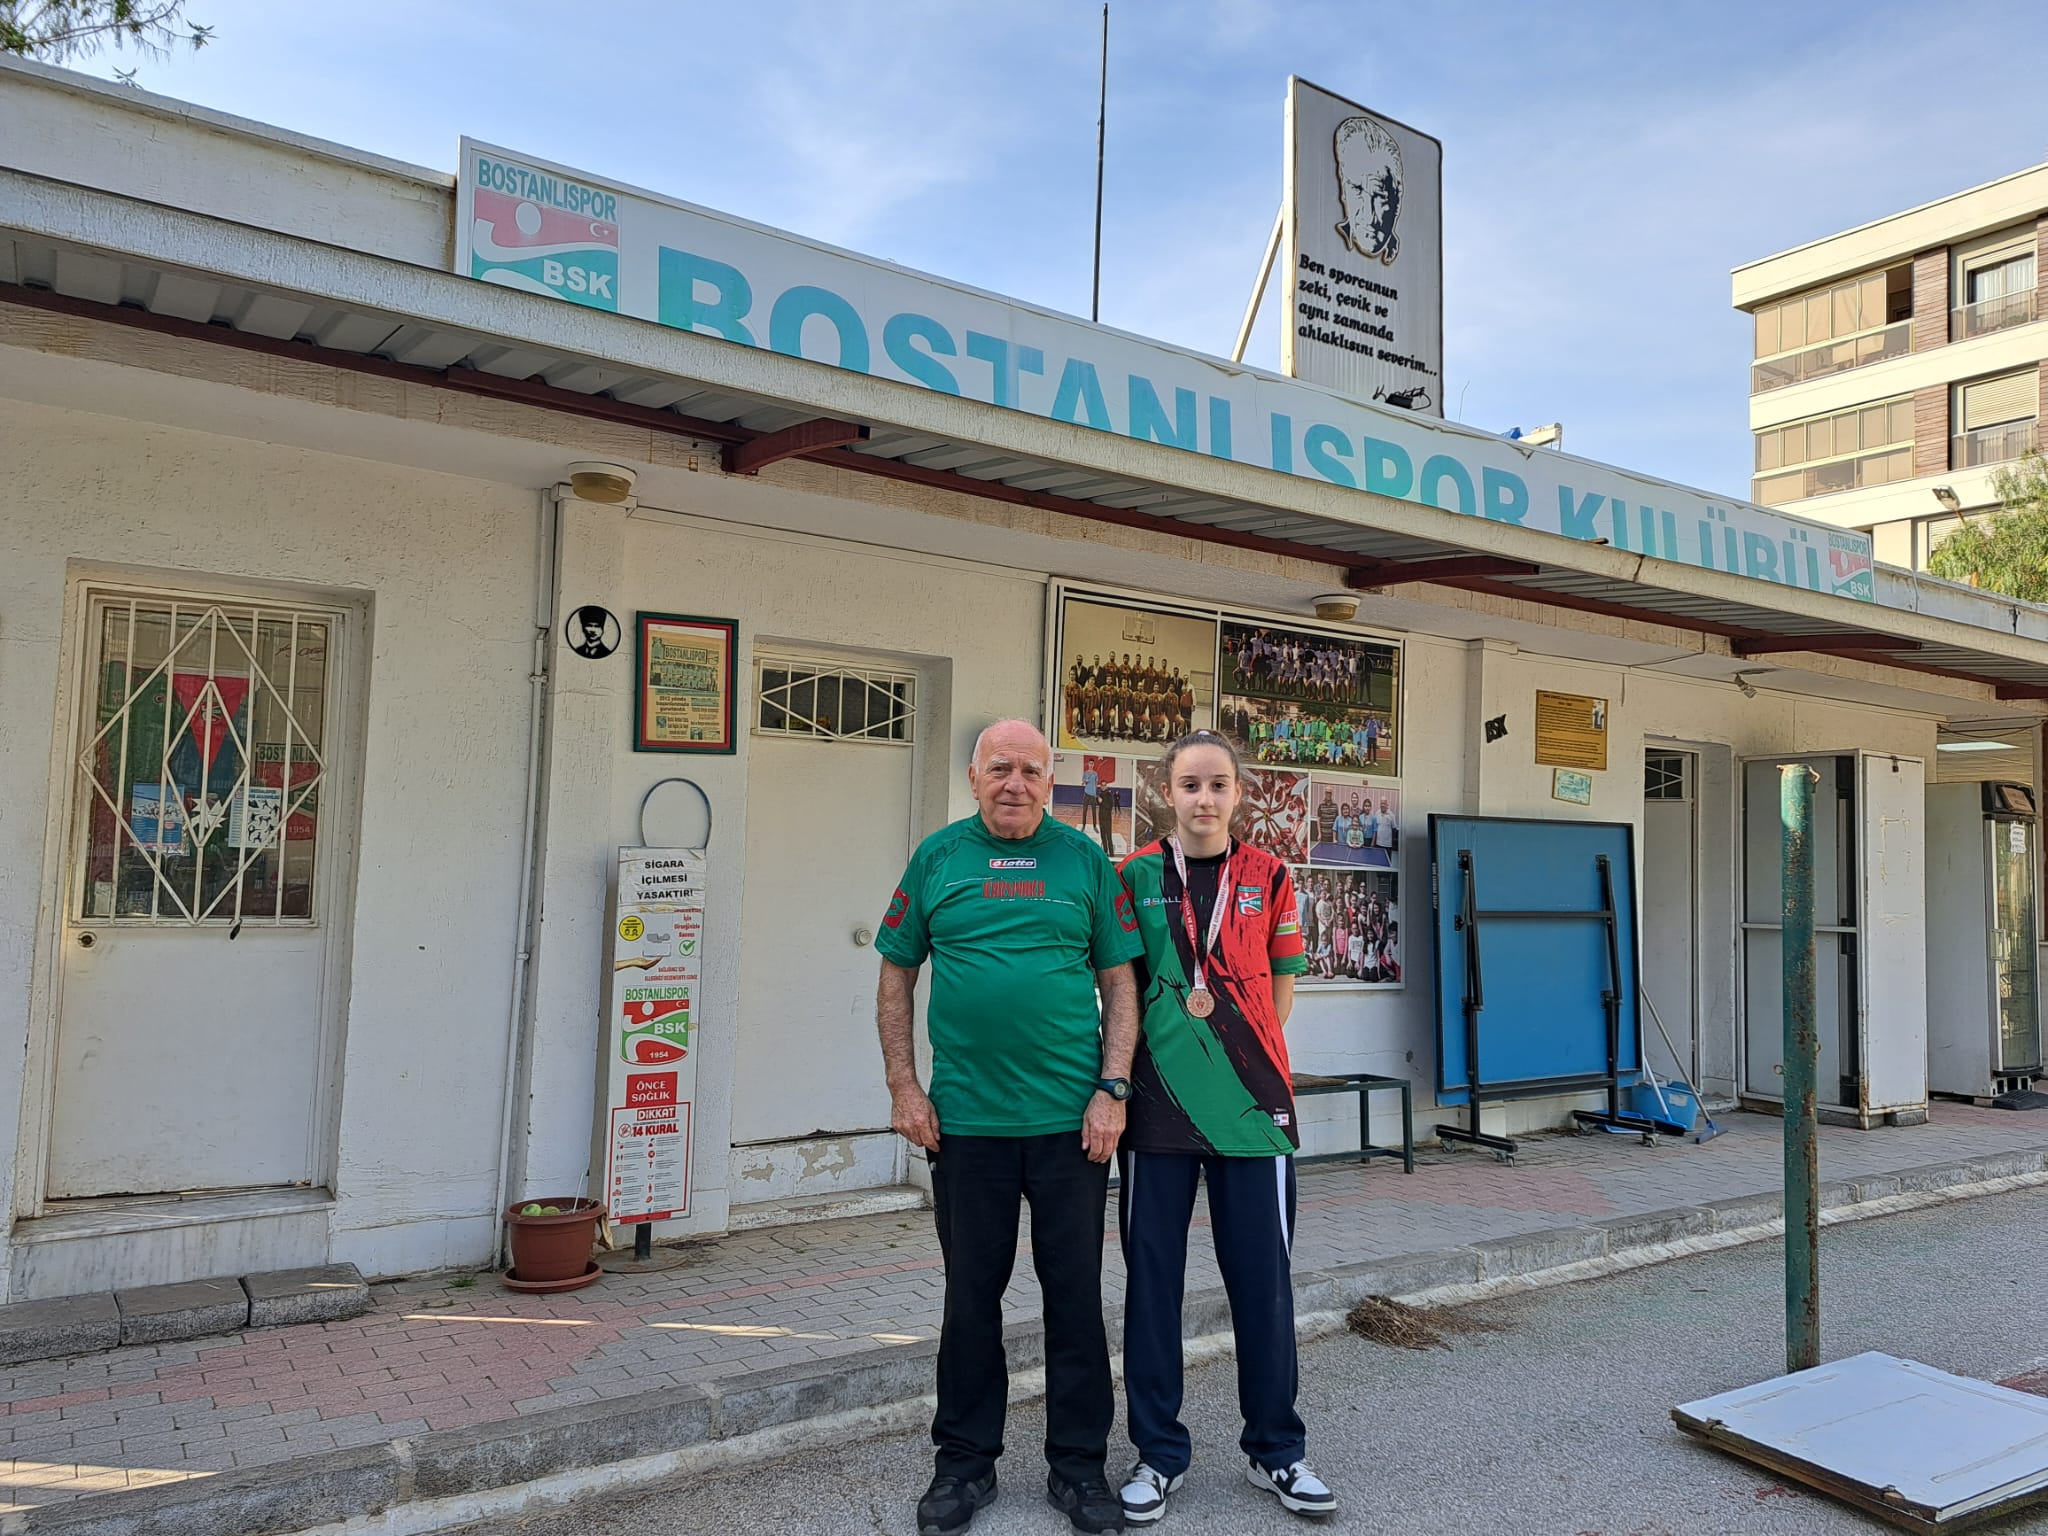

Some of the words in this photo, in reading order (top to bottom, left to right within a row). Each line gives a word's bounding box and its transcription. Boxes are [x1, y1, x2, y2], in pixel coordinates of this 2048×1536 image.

[479, 158, 617, 222] BOSTANLISPOR
[543, 258, 613, 300] BSK
[1299, 253, 1325, 276] Ben
[1328, 267, 1398, 301] sporcunun
[1298, 279, 1332, 302] zeki,
[1336, 292, 1371, 313] çevik
[1374, 304, 1389, 318] ve
[1298, 302, 1329, 321] aynı
[1333, 312, 1394, 342] zamanda
[1298, 324, 1374, 357] ahlaklısını
[1377, 348, 1438, 377] severim...
[1849, 580, 1872, 598] BSK
[644, 859, 685, 870] SİGARA
[641, 873, 688, 886] İÇİLMESİ
[636, 888, 694, 901] YASAKTIR!
[625, 986, 689, 1001] BOSTANLISPOR
[653, 1021, 687, 1035] BSK
[649, 1051, 669, 1059] 1954
[636, 1080, 667, 1091] ÖNCE
[631, 1091, 670, 1103] SAĞLIK
[632, 1125, 643, 1137] 14
[645, 1123, 679, 1136] KURAL
